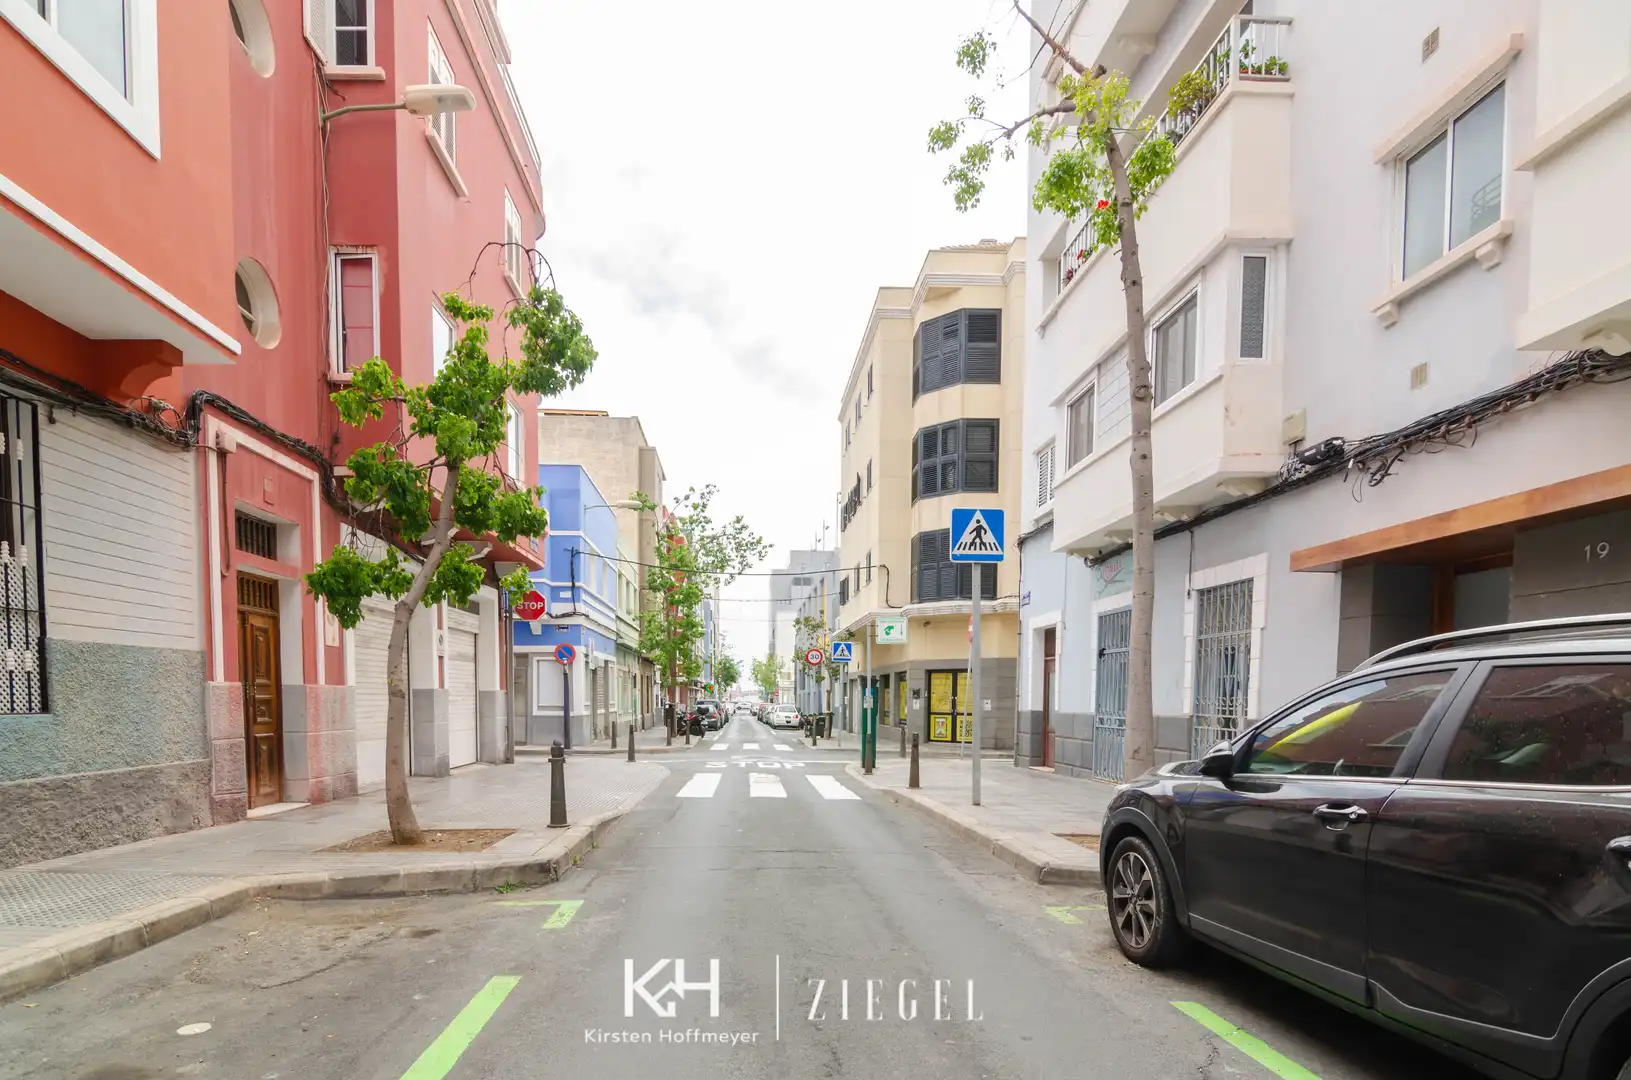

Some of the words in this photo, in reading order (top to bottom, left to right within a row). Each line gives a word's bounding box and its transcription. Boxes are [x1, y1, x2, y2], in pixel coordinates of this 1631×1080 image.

[1584, 541, 1610, 563] 19
[516, 601, 544, 610] STOP
[705, 760, 806, 769] STOP
